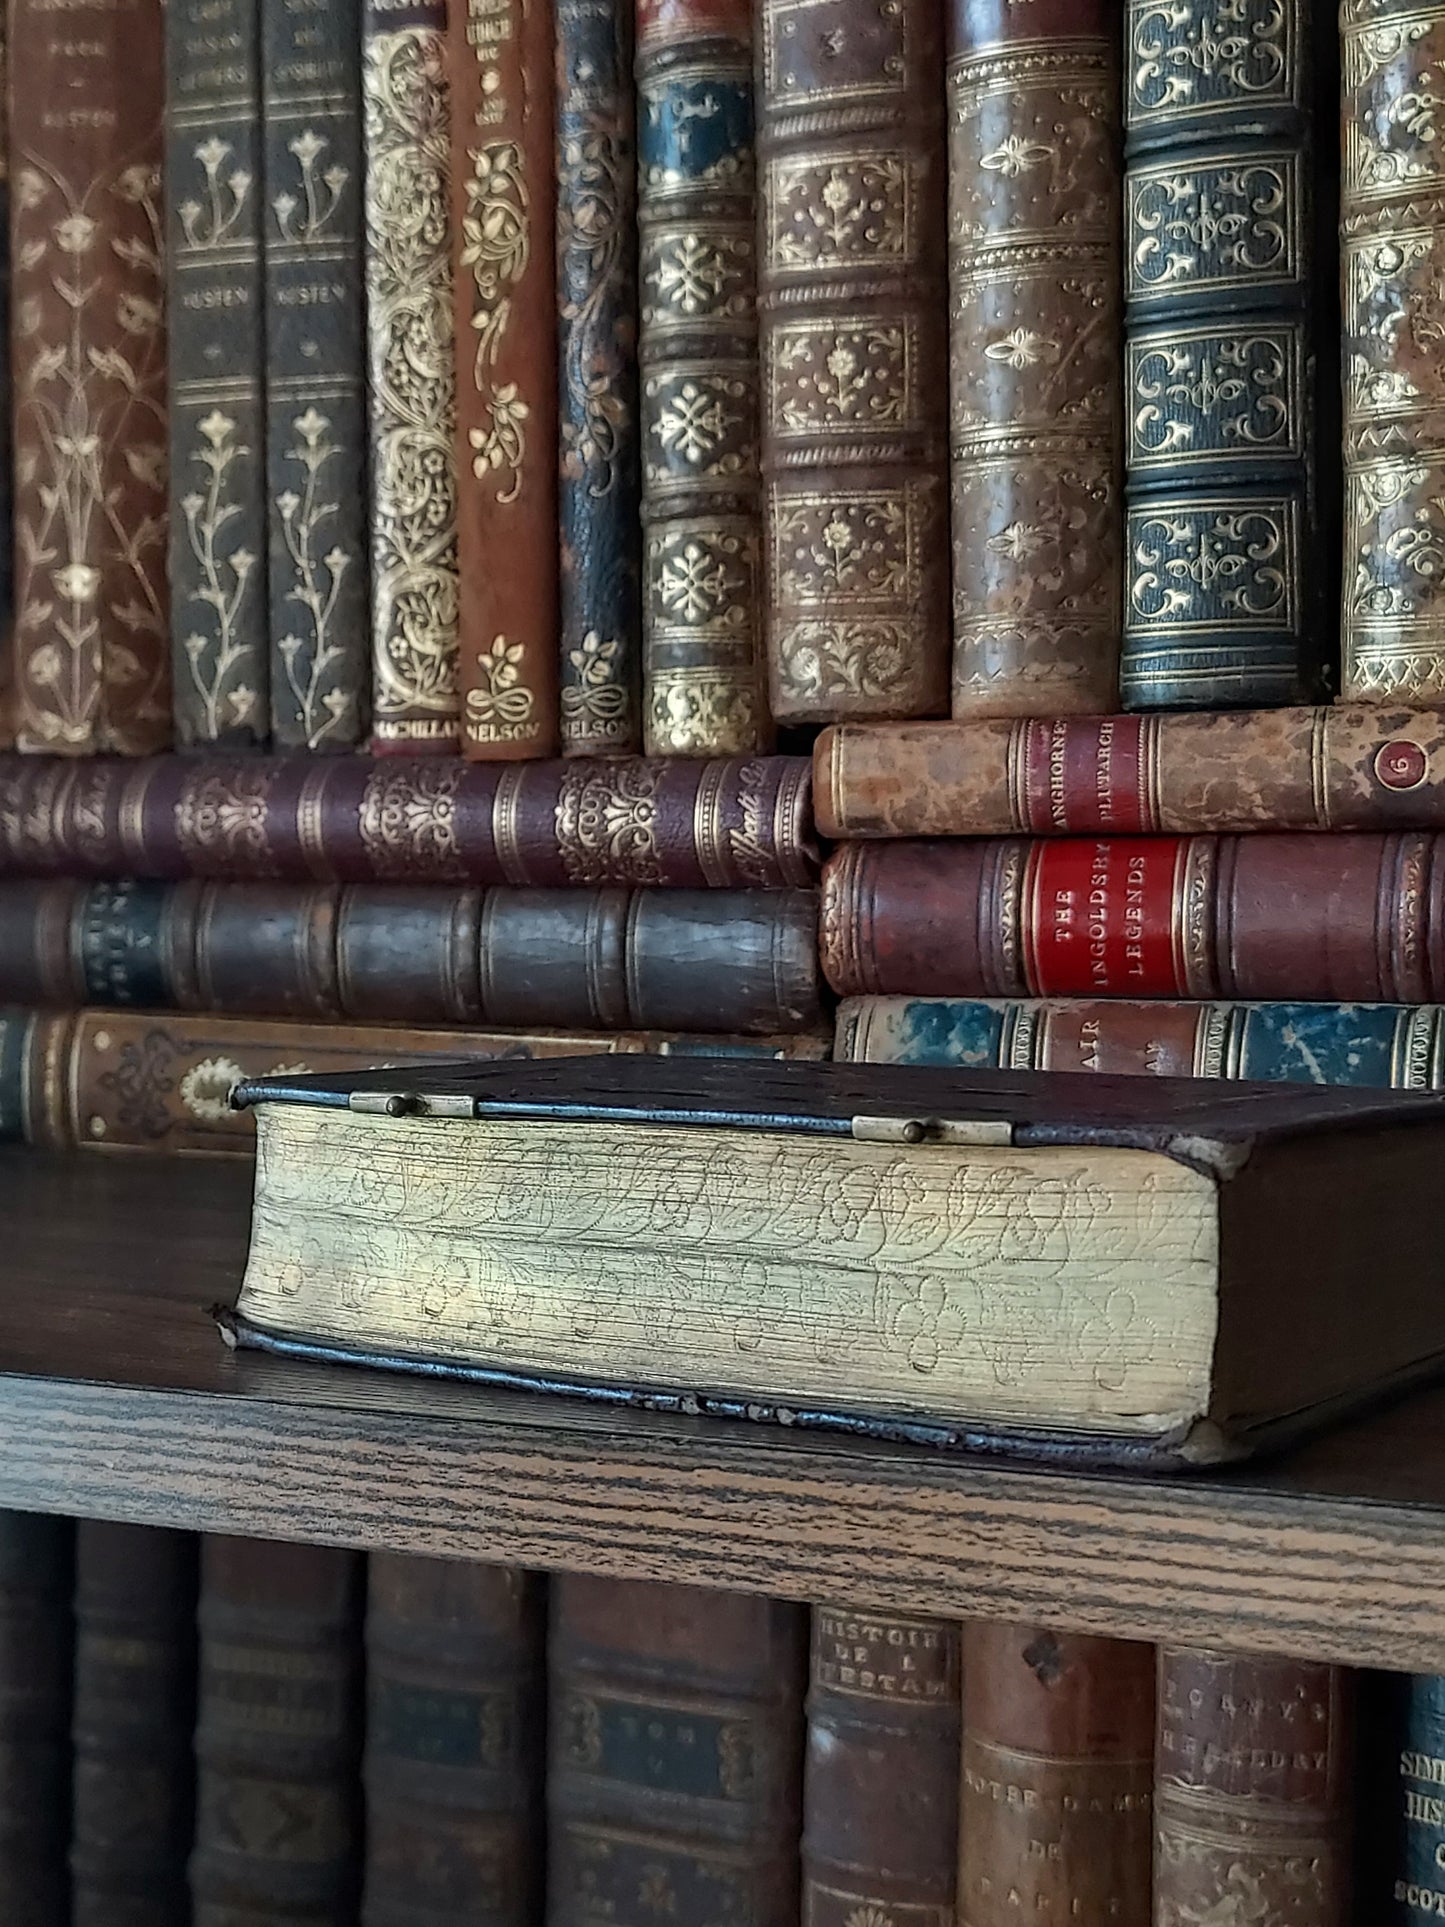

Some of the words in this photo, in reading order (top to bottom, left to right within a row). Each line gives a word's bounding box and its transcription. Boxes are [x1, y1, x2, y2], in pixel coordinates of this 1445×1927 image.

[466, 722, 541, 743] NELSON
[563, 719, 628, 738] NELSO
[1096, 721, 1114, 821] PLUTARCH
[1055, 889, 1072, 942] THE
[1088, 842, 1111, 986] INGOLDSBY
[1126, 856, 1145, 978] LEGENDS
[1162, 1730, 1324, 1769] HERDRY
[1404, 1790, 1445, 1825] HIS
